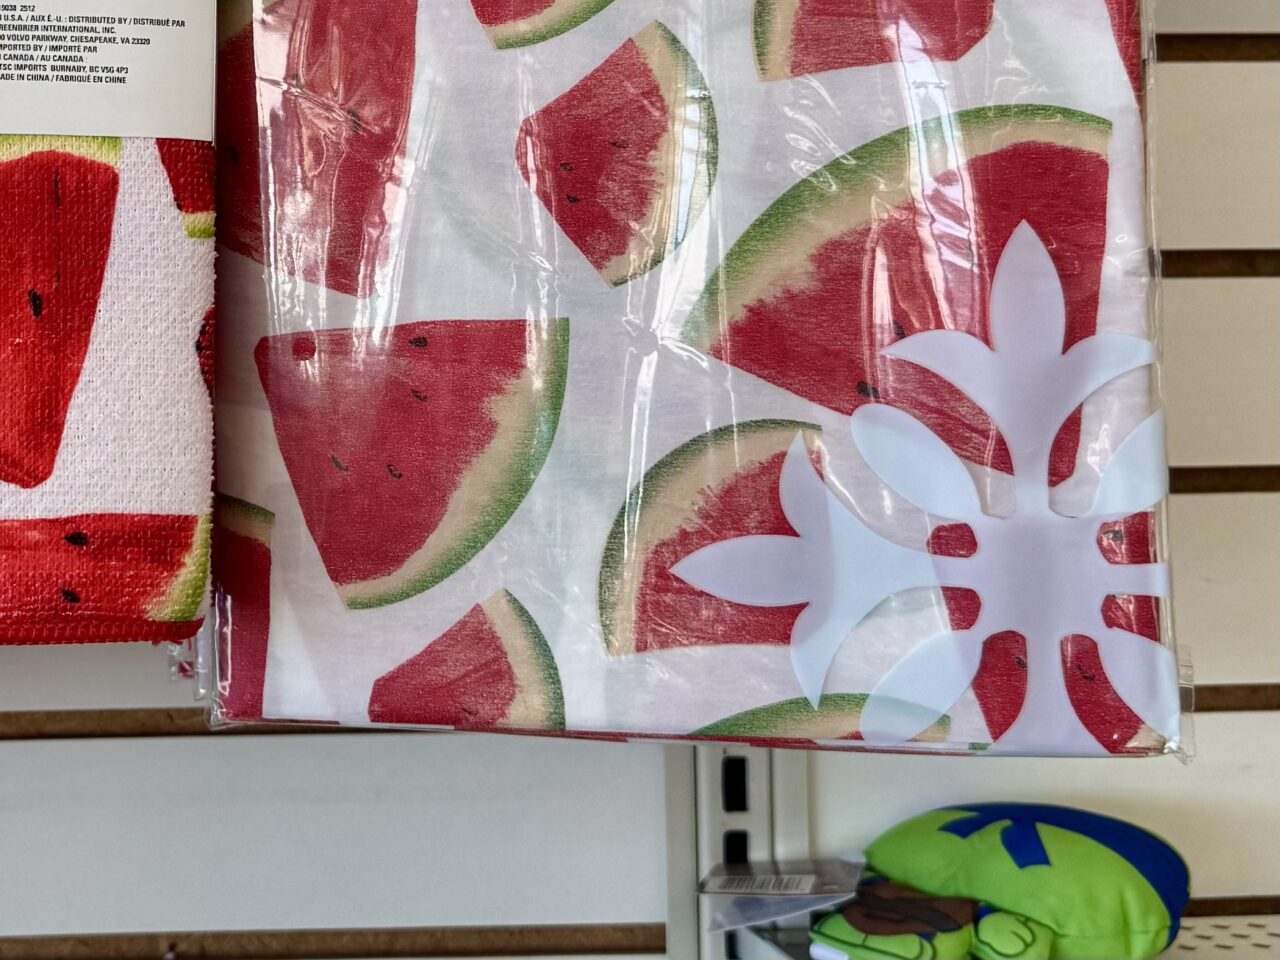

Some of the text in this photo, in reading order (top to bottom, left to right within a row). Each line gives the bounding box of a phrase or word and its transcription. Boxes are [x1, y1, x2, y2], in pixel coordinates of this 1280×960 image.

[68, 16, 116, 24] DISTRIBUTED
[118, 17, 128, 25] BY
[133, 18, 171, 27] DISTRIBUÉ
[171, 19, 186, 28] PAR
[102, 26, 117, 35] INC.
[6, 34, 30, 42] VOLVO
[120, 37, 131, 45] VA
[32, 44, 43, 52] BY
[48, 44, 82, 53] IMPORTÉ
[83, 45, 98, 53] PAR
[3, 53, 35, 61] CANADA
[52, 54, 84, 63] CANADA
[13, 63, 48, 72] IMPORTS
[100, 66, 115, 74] V5G
[115, 67, 129, 75] 4P3
[16, 73, 26, 81] IN
[26, 73, 50, 82] CHINA
[55, 73, 92, 83] FABRIQUÉ
[92, 75, 103, 83] EN
[104, 76, 127, 84] CHINE
